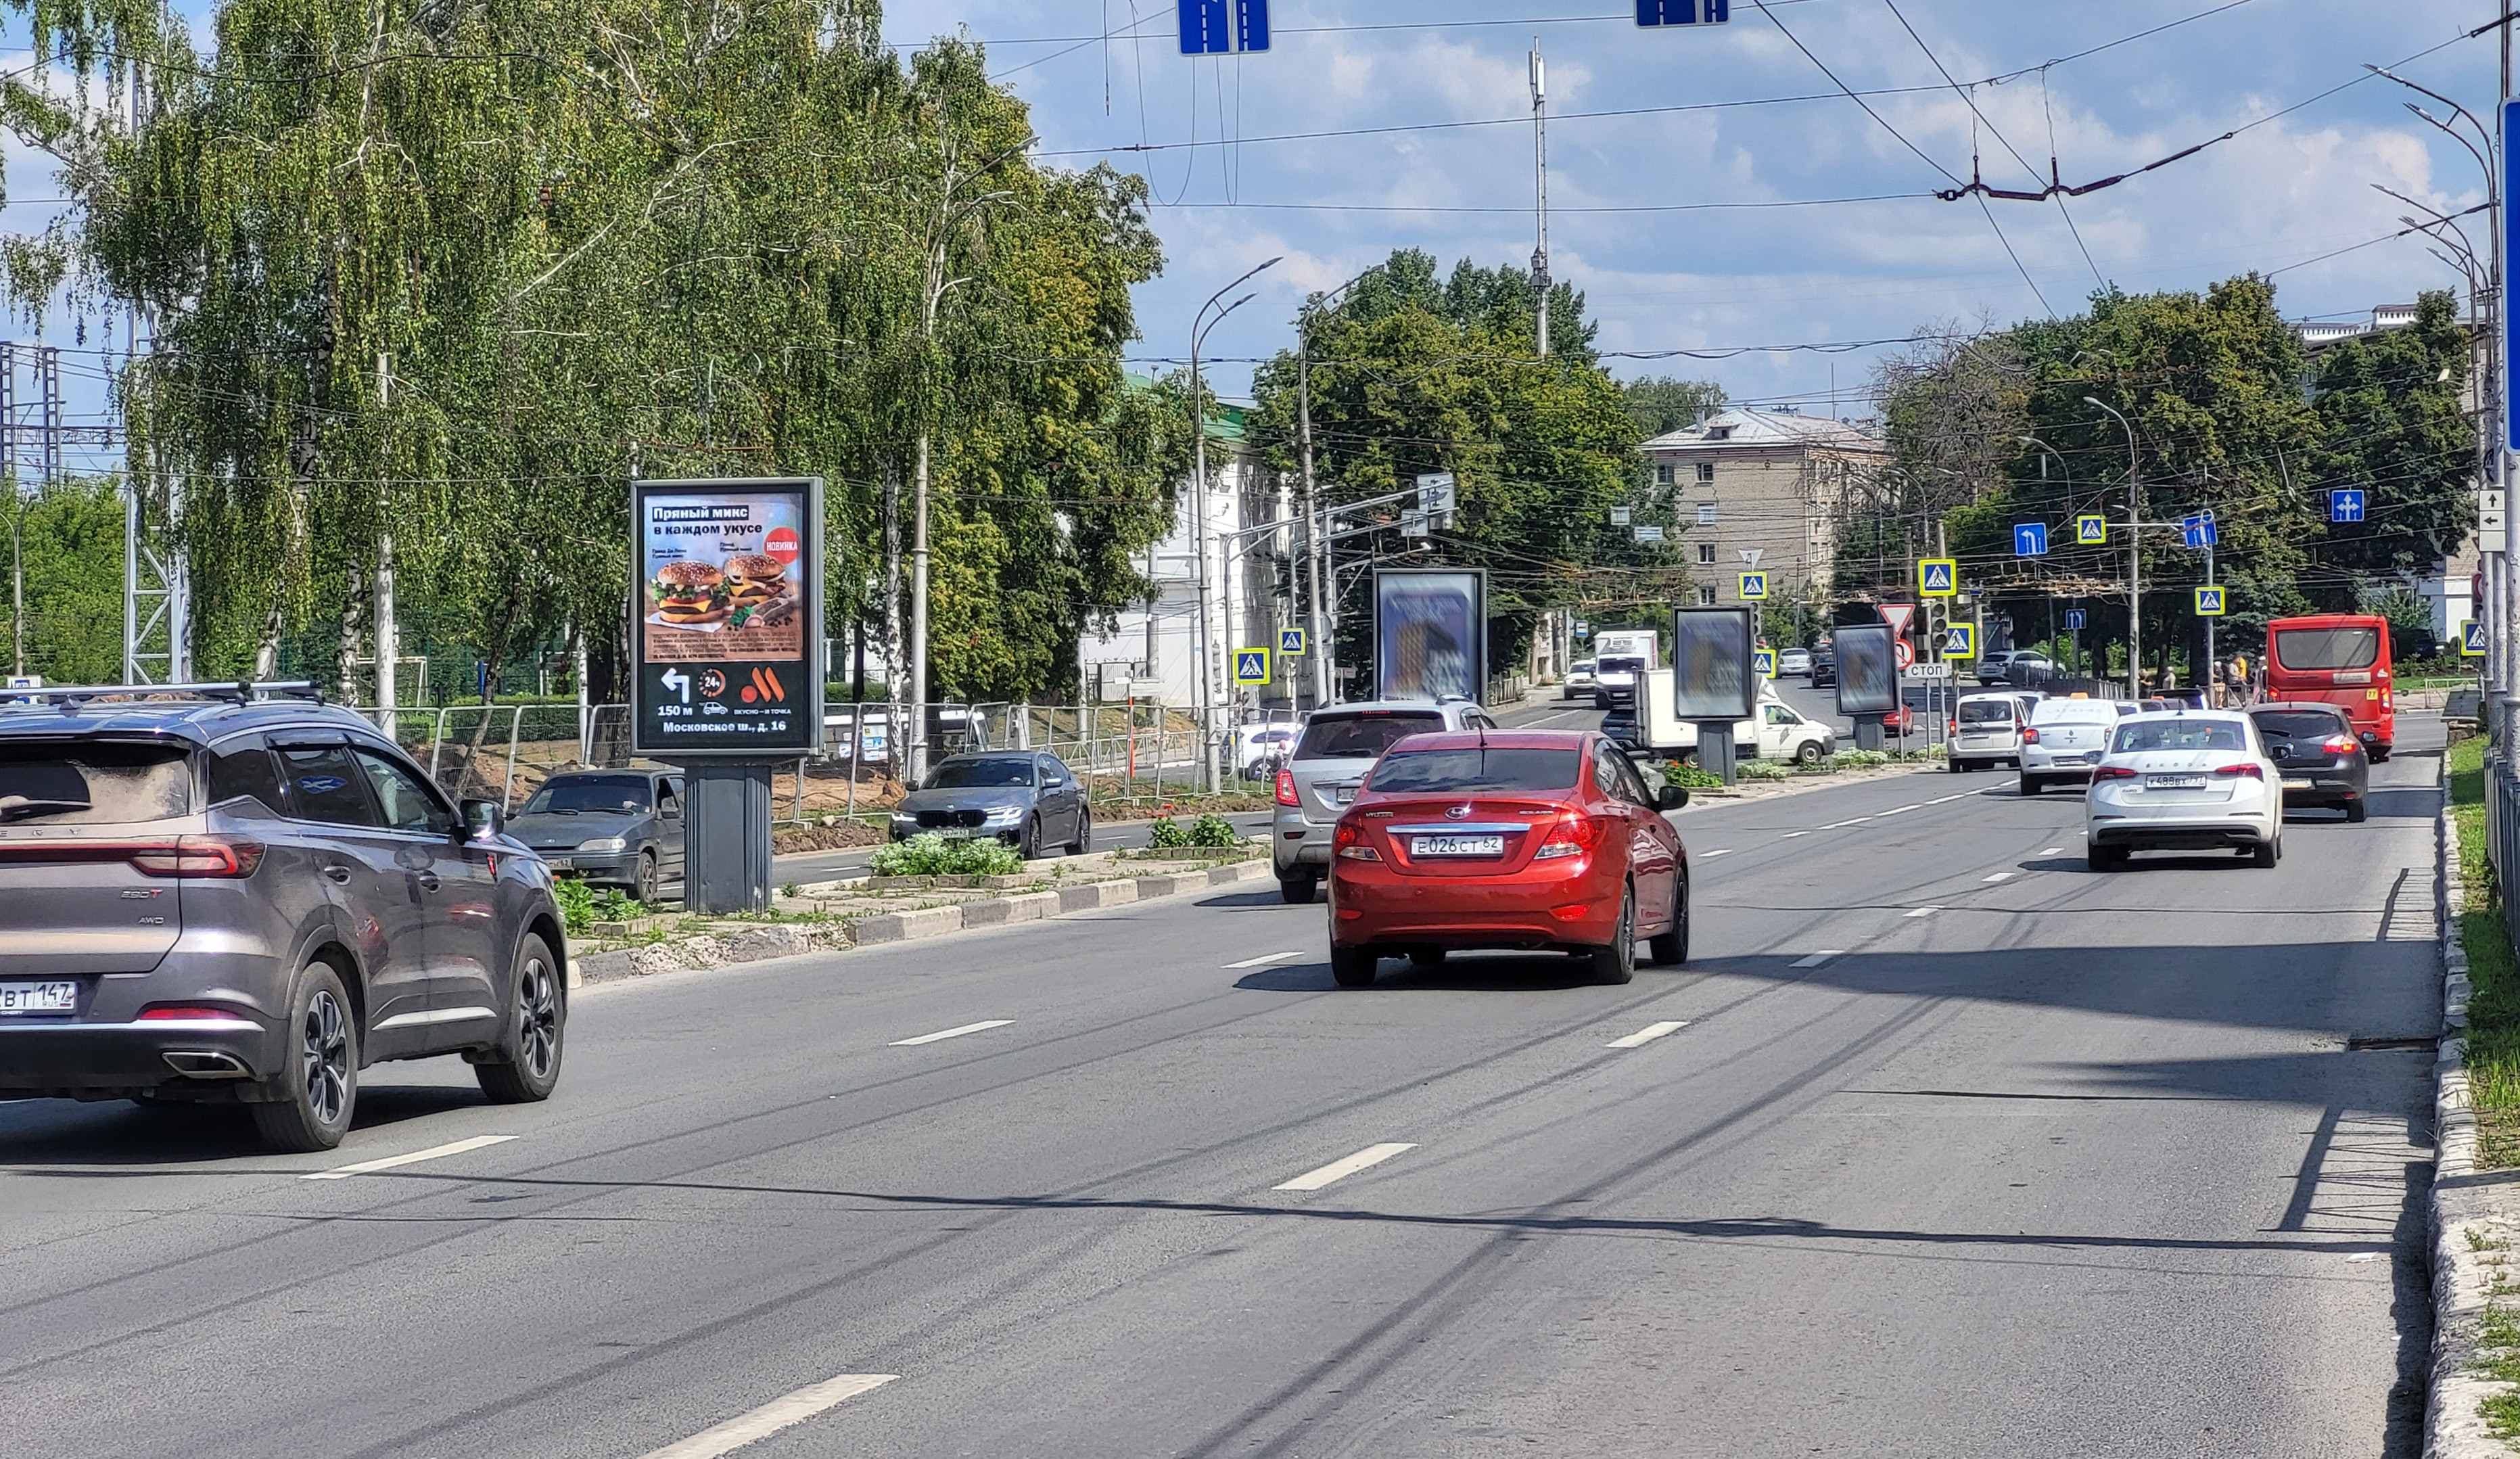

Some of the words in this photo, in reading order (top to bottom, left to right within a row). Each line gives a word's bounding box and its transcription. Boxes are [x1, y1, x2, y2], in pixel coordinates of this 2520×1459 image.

[654, 506, 709, 521] Пряный
[712, 508, 748, 518] микс
[666, 526, 720, 536] каждом
[724, 525, 762, 536] укусе
[766, 541, 797, 551] НОВИНКА
[1911, 666, 1942, 675] СТОП
[657, 705, 680, 716] 150
[682, 708, 693, 716] м
[663, 722, 735, 732] Московское
[738, 724, 755, 733] ш.,
[757, 723, 768, 733] д.
[771, 720, 786, 731] 16
[38, 983, 70, 1000] 147
